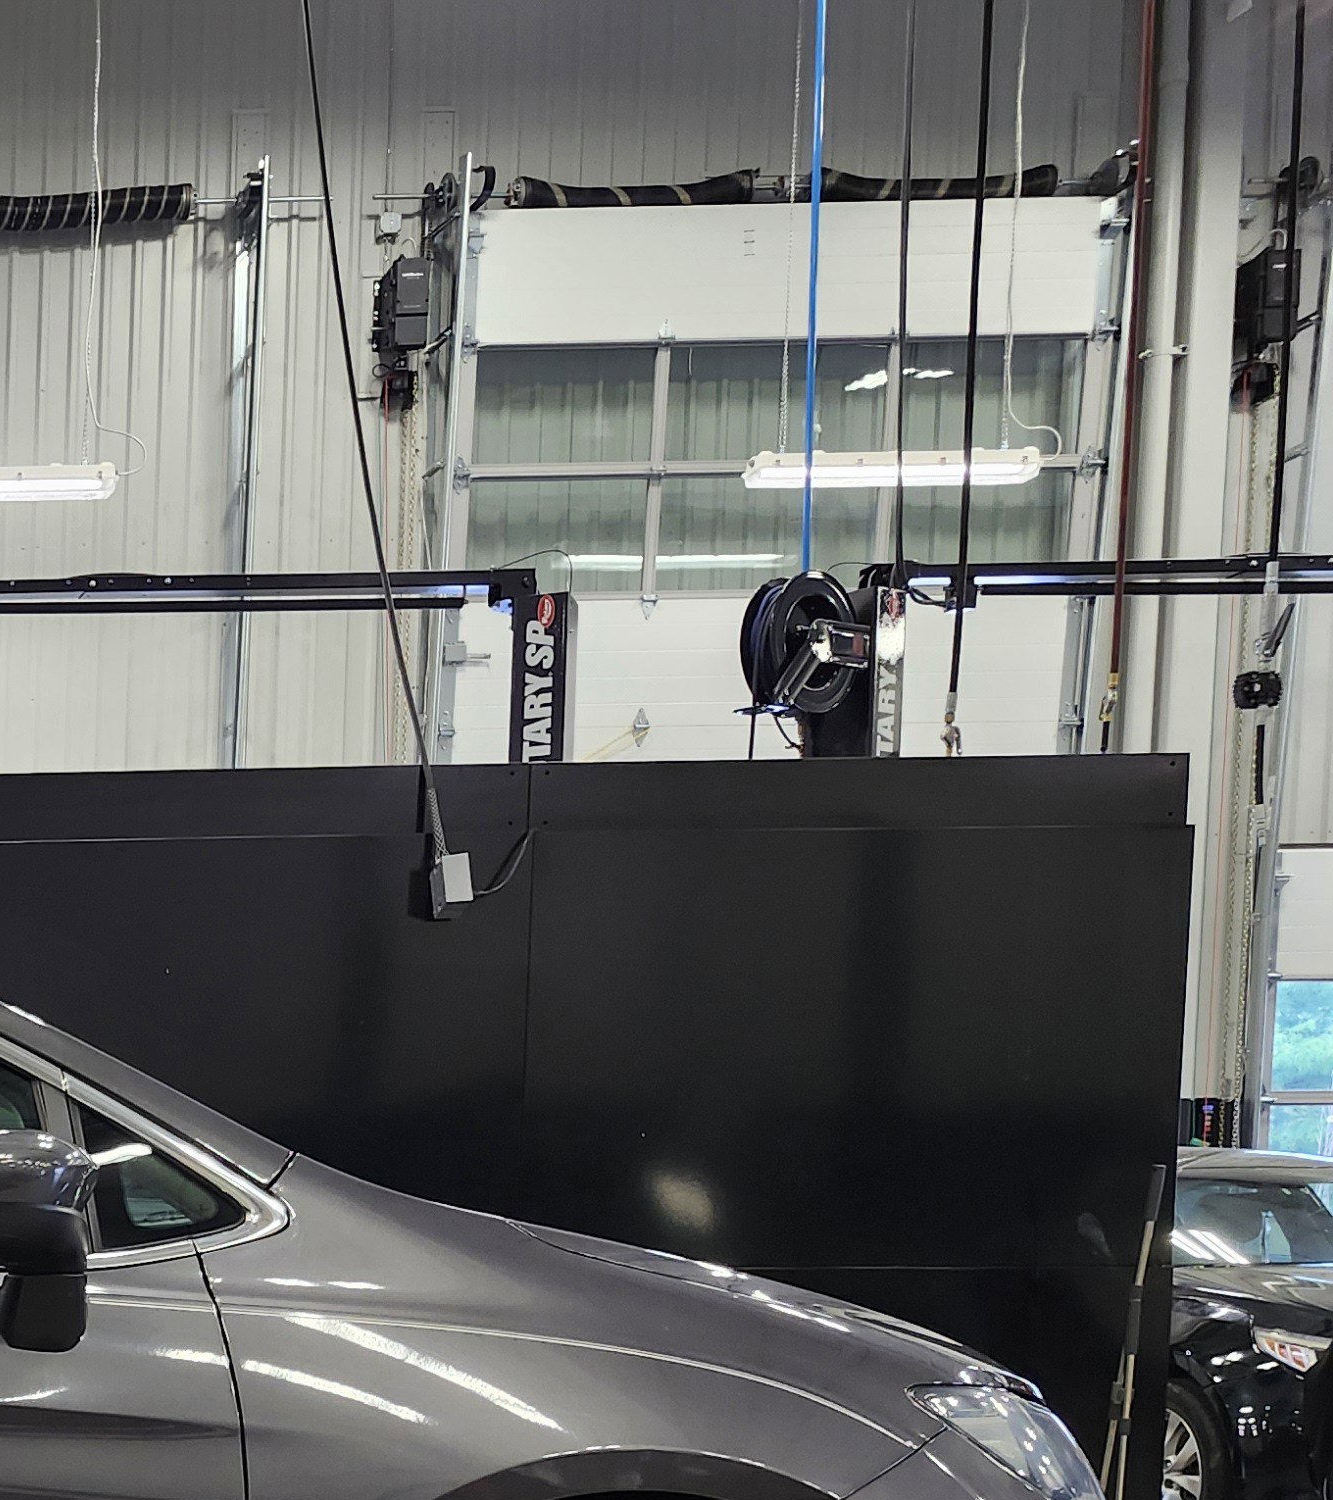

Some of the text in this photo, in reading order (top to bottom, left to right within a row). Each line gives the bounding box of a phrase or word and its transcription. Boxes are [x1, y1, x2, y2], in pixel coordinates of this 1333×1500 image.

[525, 620, 555, 670] SP
[522, 672, 554, 764] TARY
[876, 665, 897, 757] TARY
